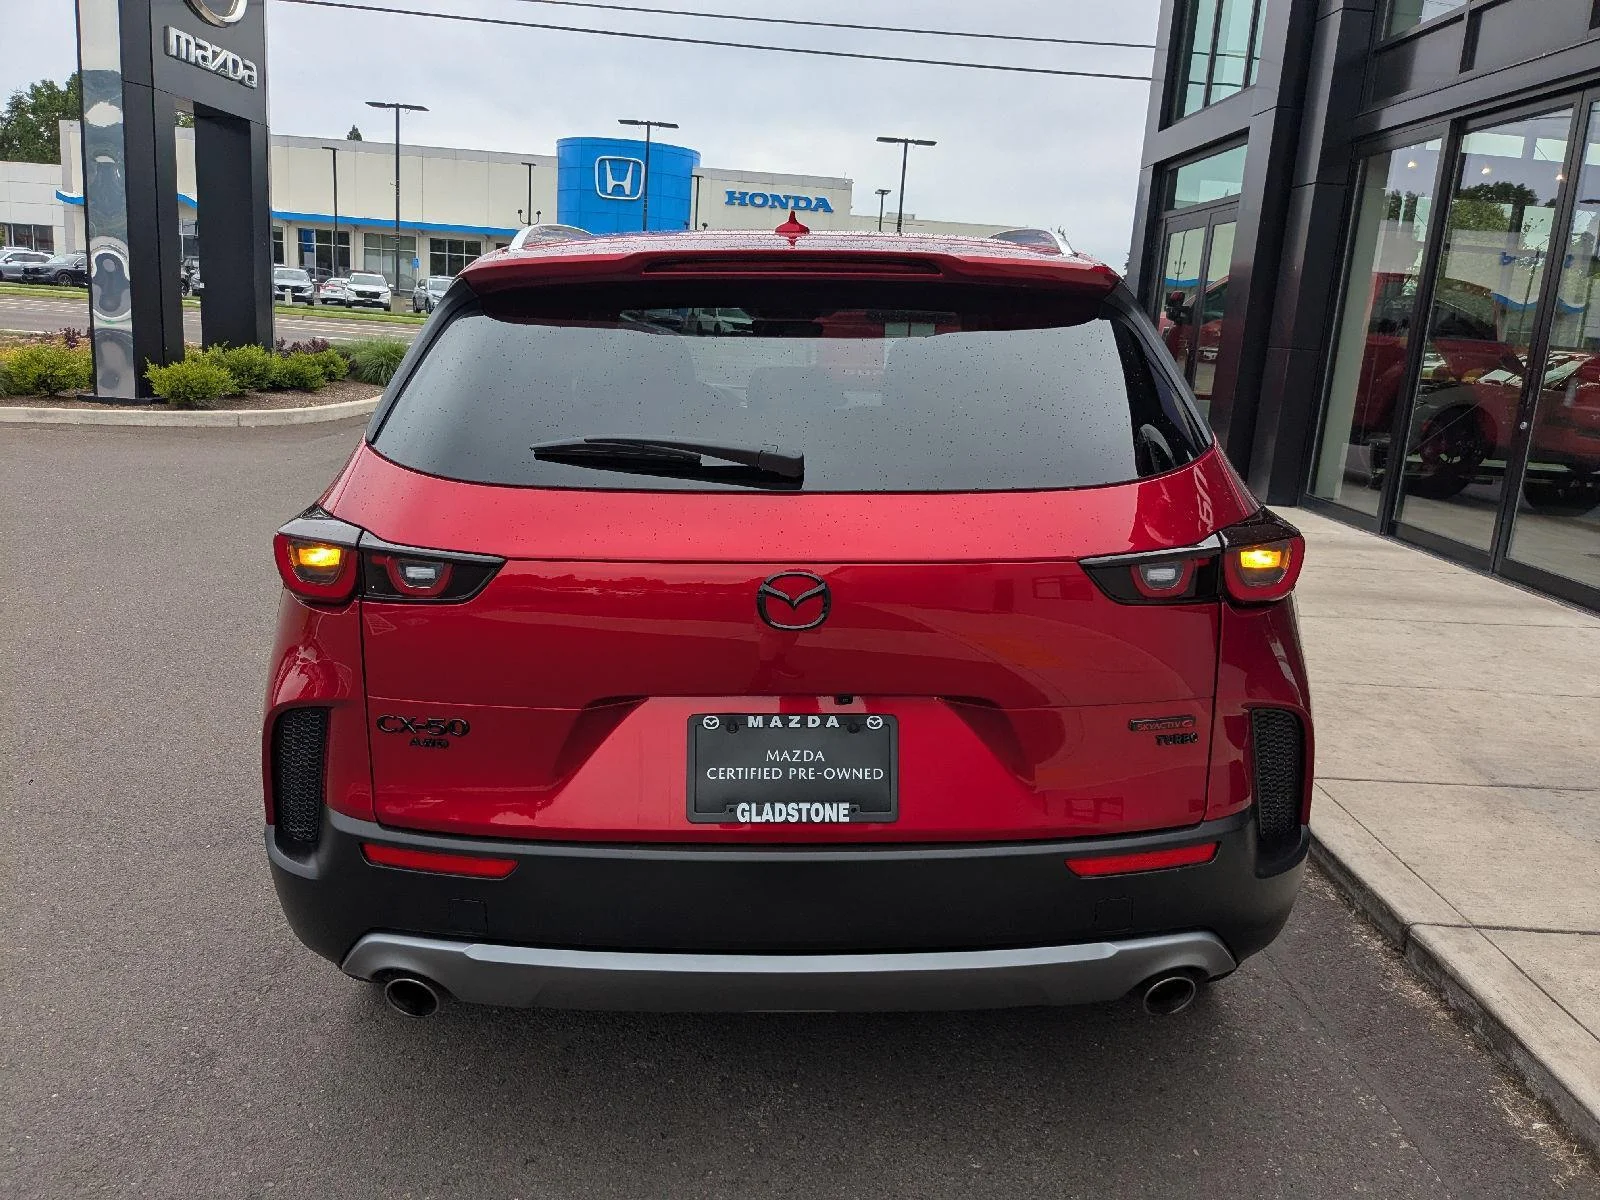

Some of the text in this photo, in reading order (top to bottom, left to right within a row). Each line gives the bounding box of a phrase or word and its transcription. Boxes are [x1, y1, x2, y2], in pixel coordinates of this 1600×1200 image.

[725, 190, 834, 213] HONDA
[376, 714, 471, 737] CX-50
[747, 715, 840, 728] MAZDA
[1156, 732, 1198, 746] TURBO
[765, 750, 825, 762] MAZDA
[706, 768, 884, 780] CERTIFIED PRE-OWNED
[736, 802, 850, 823] GLADSTONE
